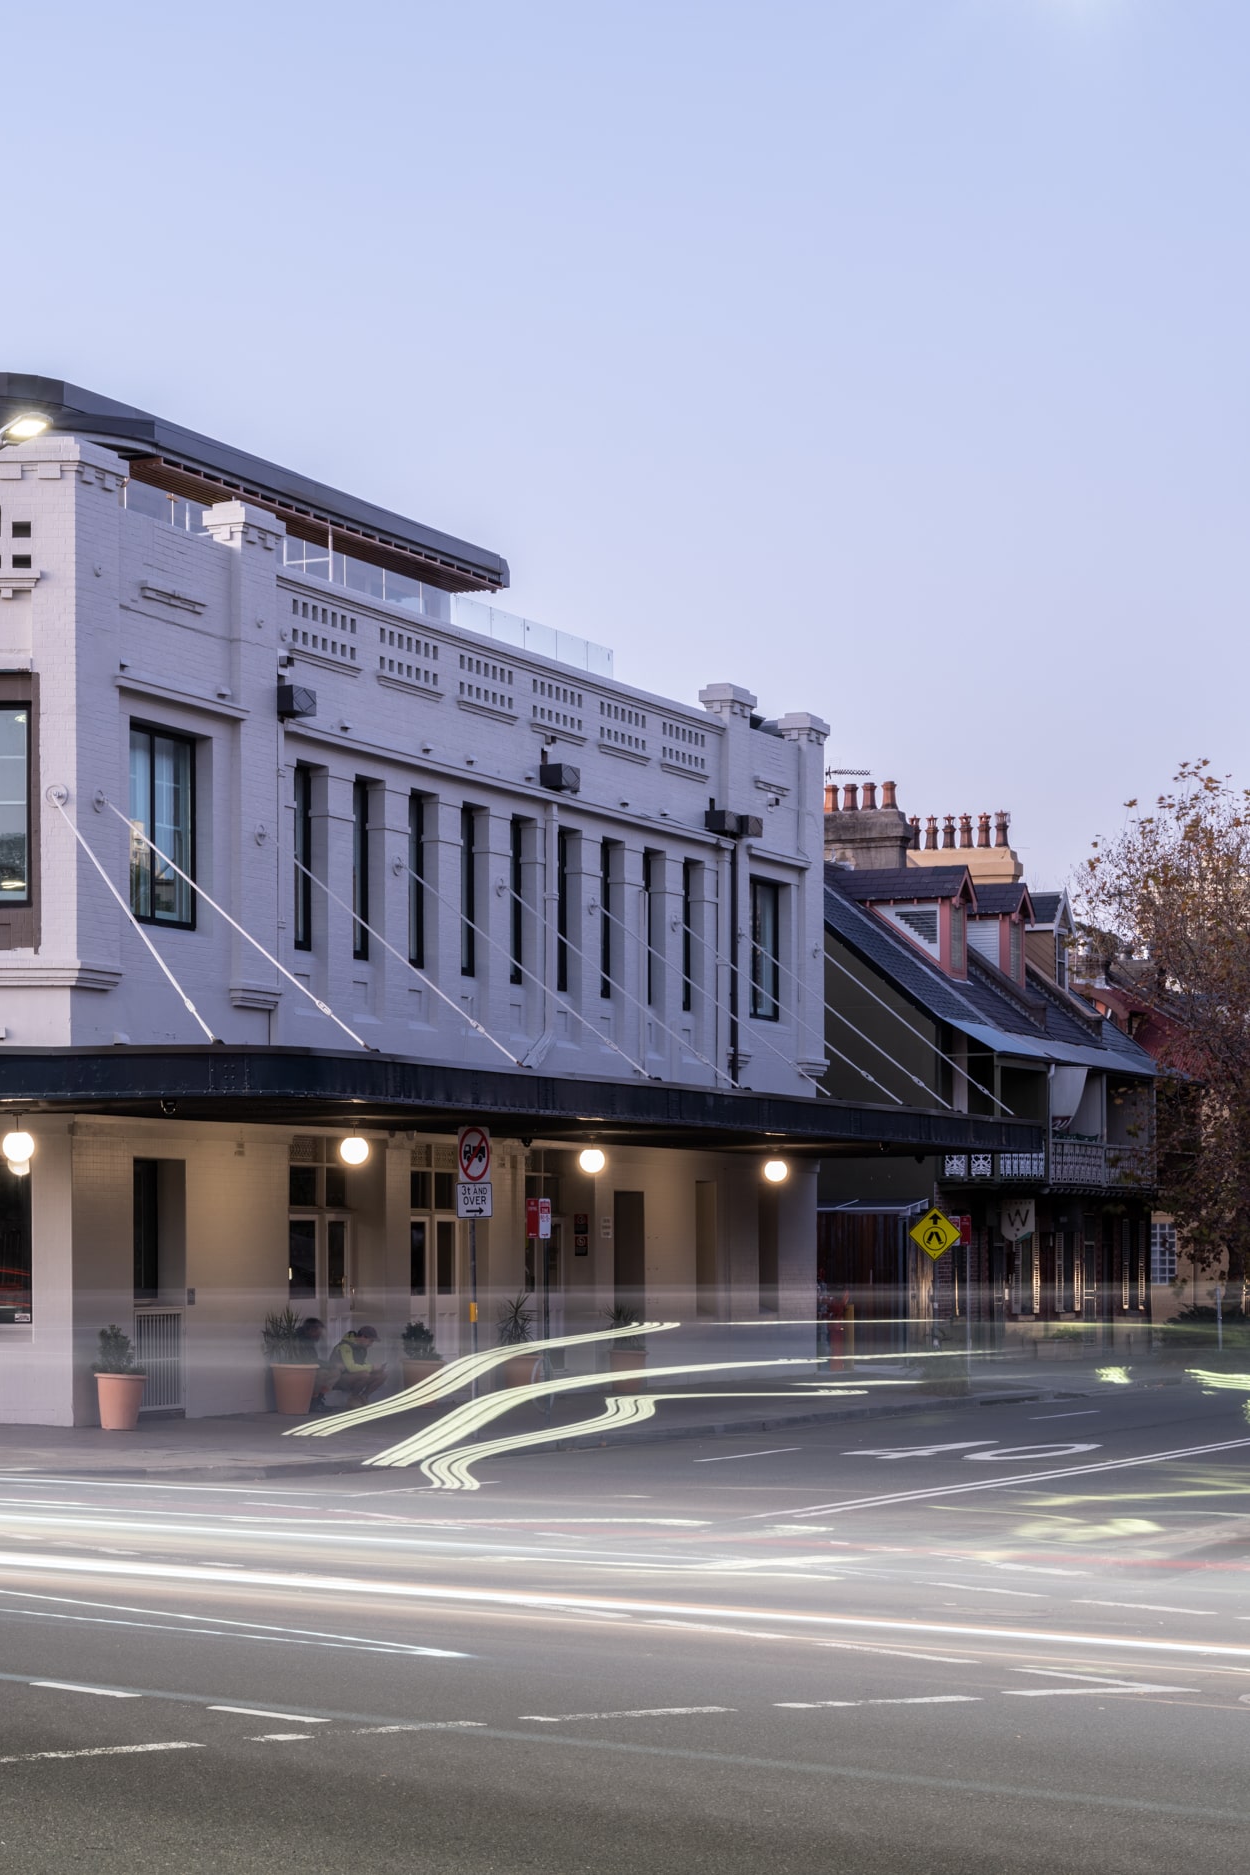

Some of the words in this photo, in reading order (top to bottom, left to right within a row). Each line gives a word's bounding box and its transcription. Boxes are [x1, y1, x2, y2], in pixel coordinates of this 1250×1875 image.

[461, 1185, 471, 1196] 3t
[473, 1186, 488, 1196] AND
[463, 1196, 487, 1206] OVER
[839, 1440, 1103, 1461] 40
